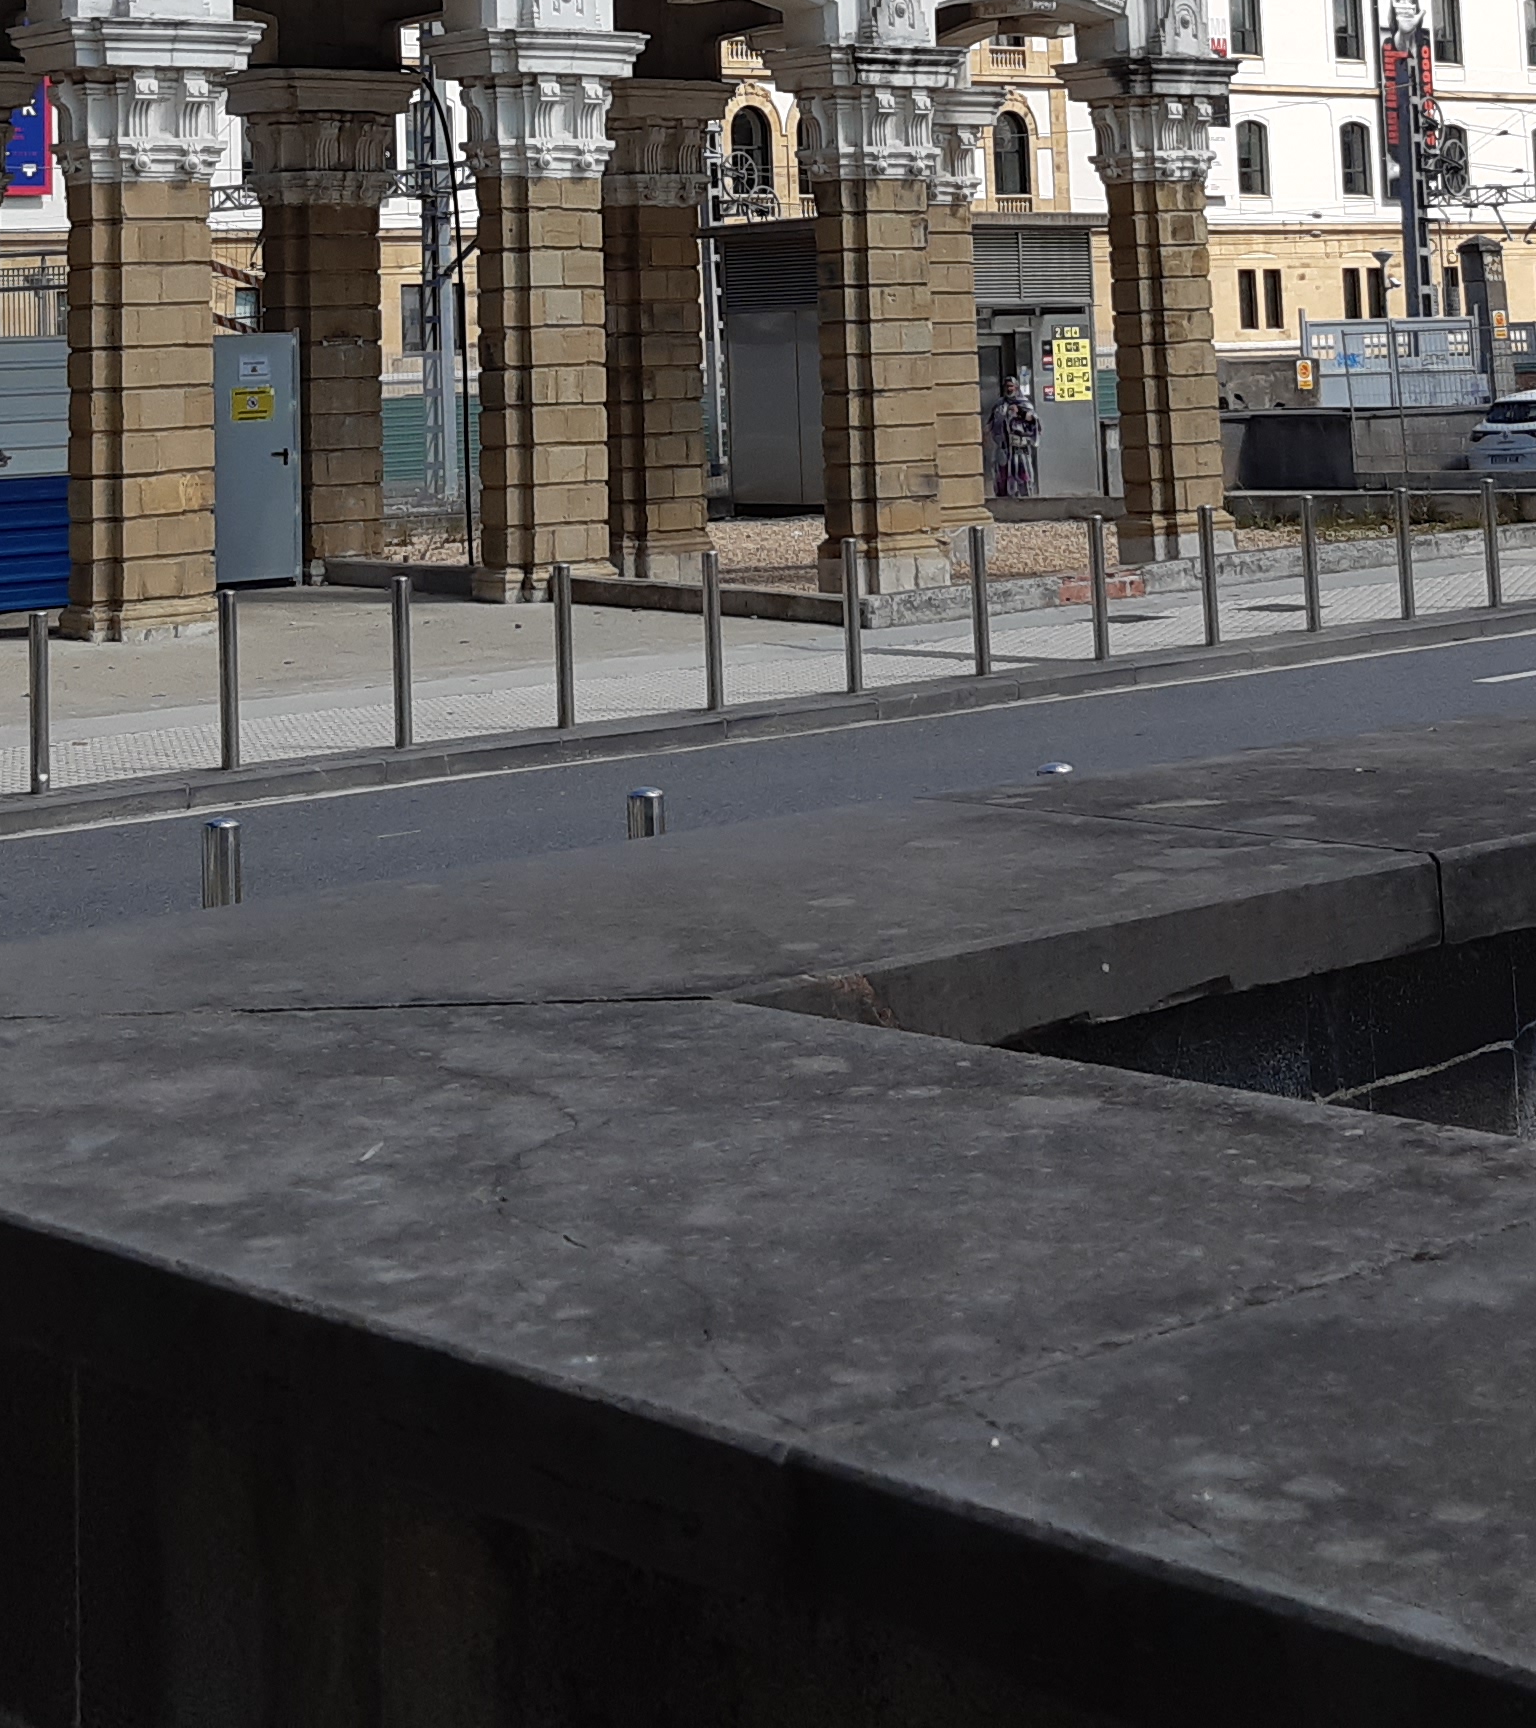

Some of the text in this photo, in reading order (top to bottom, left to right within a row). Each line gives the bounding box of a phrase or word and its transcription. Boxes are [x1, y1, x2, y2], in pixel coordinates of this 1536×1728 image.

[1055, 327, 1062, 338] 2
[1056, 343, 1061, 354] 1
[1056, 358, 1062, 368] 0
[1056, 373, 1063, 382] -1
[1057, 388, 1065, 398] -2
